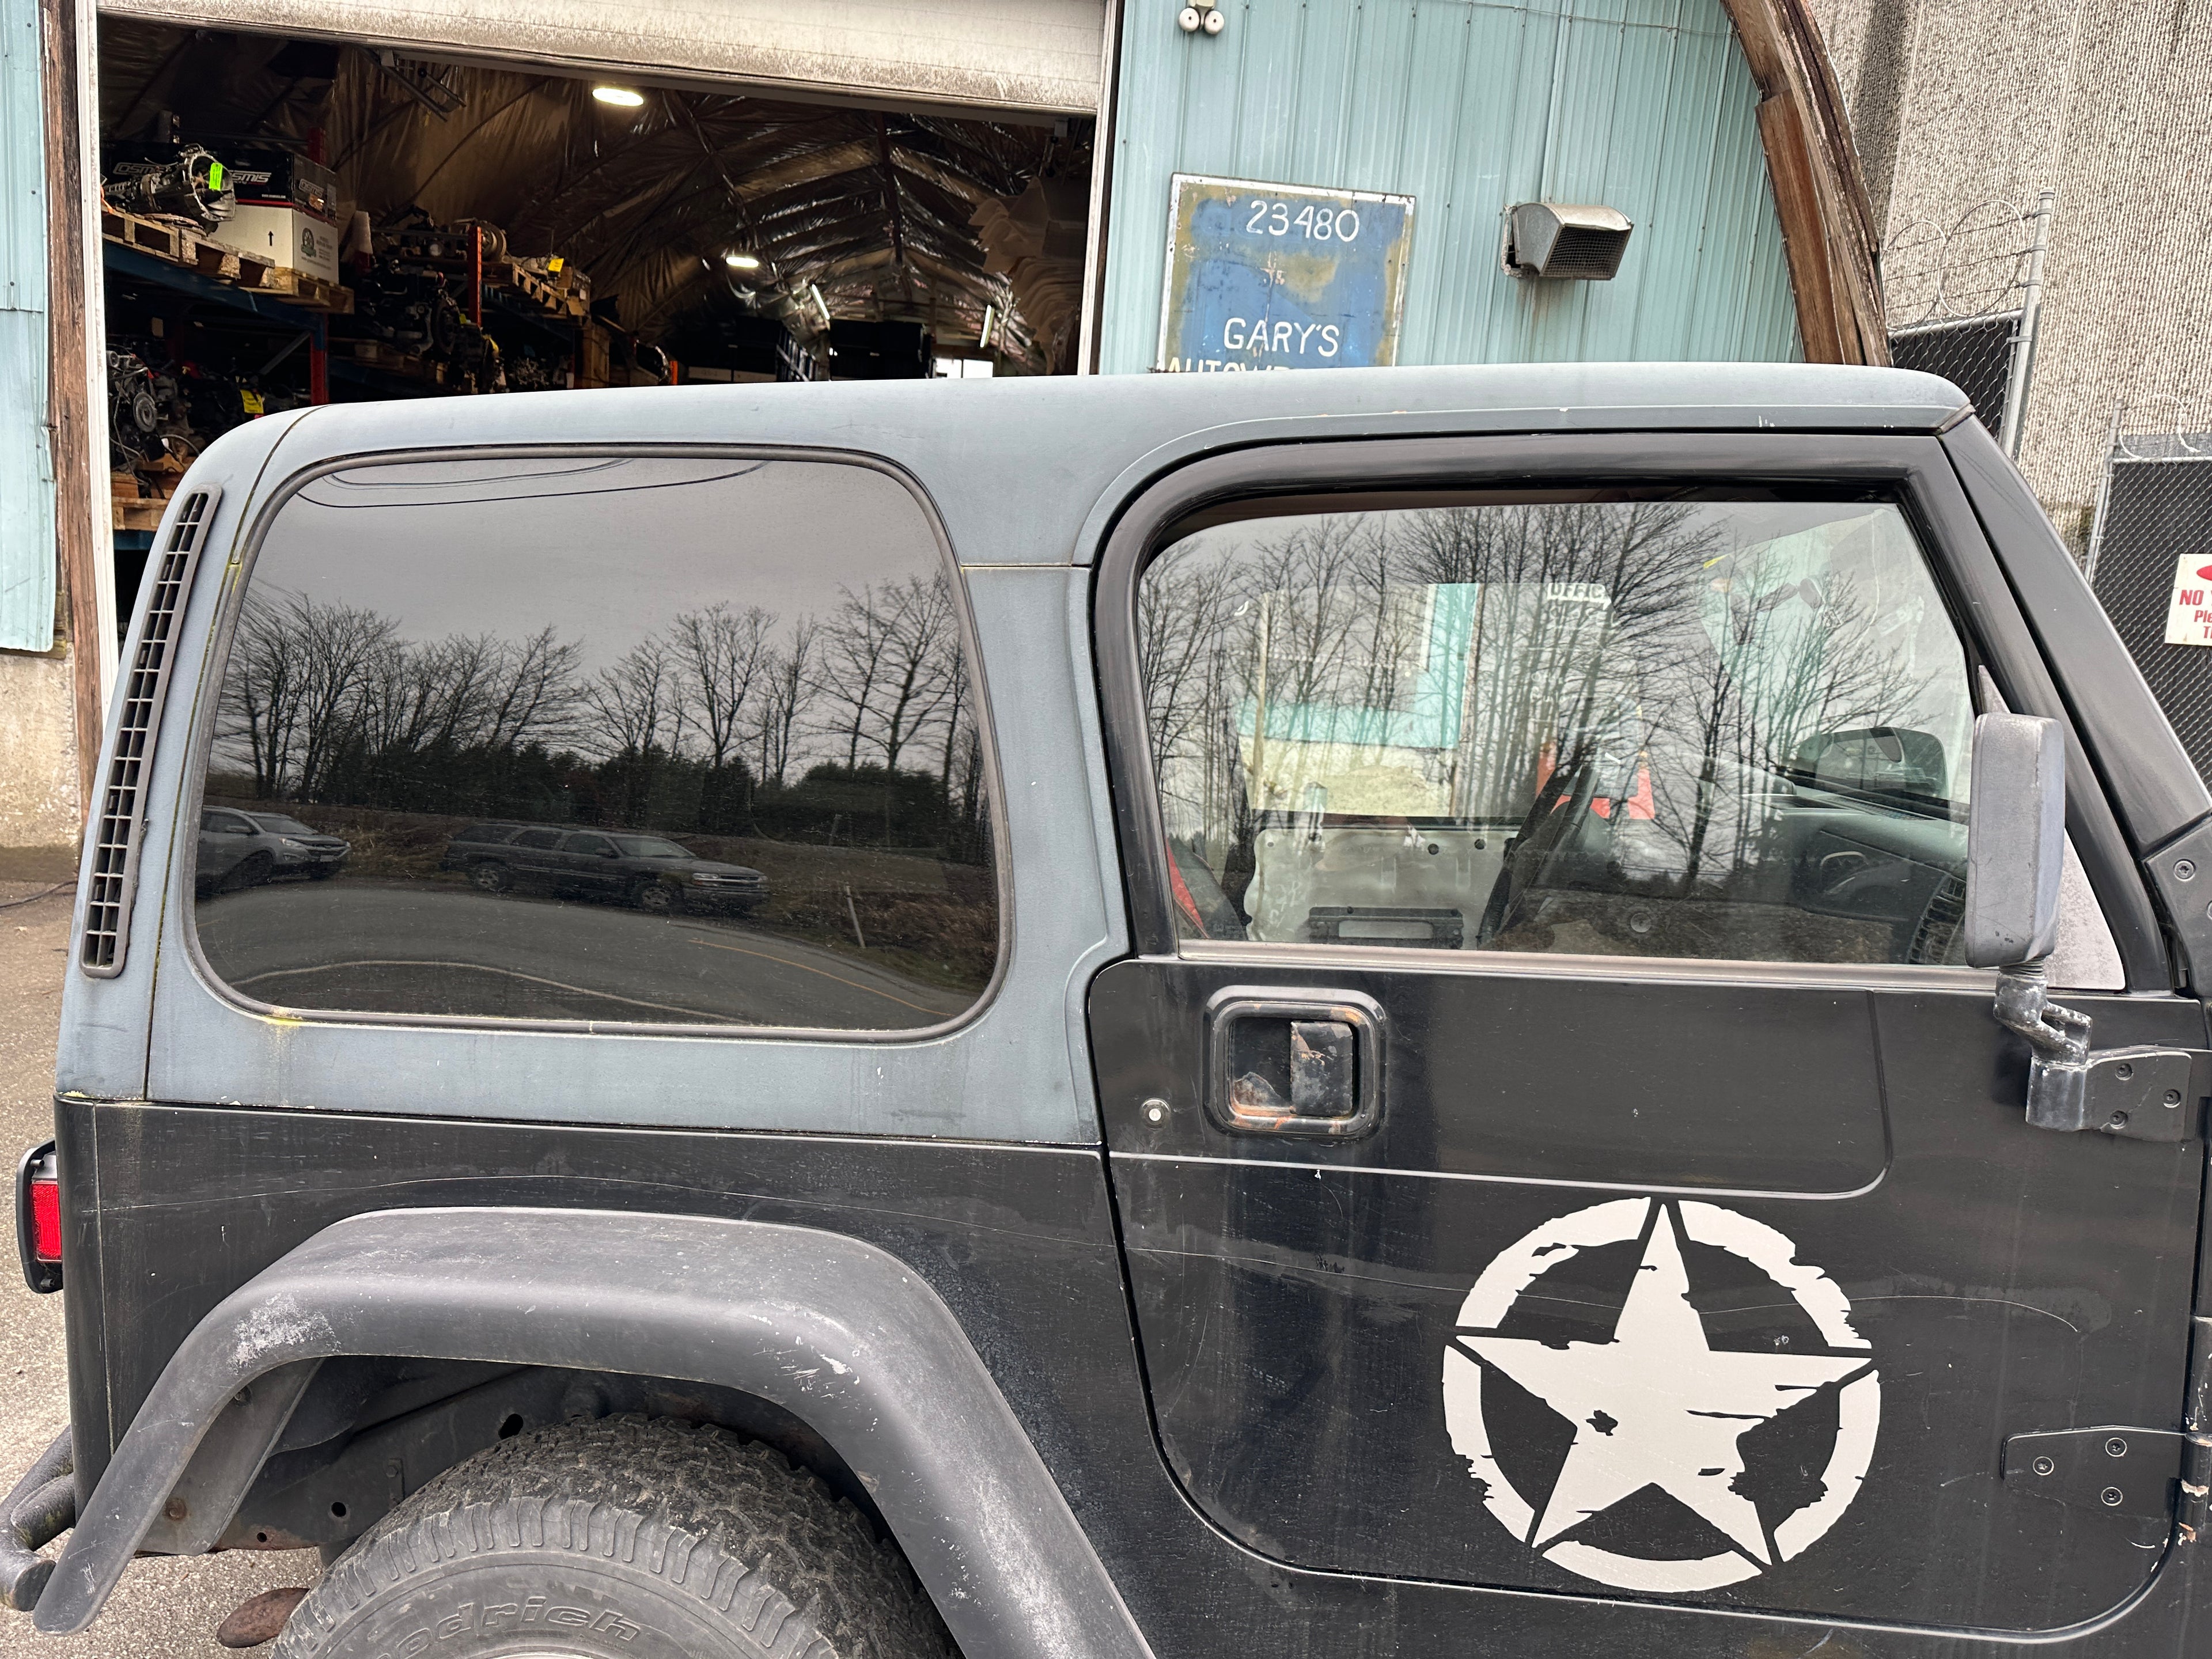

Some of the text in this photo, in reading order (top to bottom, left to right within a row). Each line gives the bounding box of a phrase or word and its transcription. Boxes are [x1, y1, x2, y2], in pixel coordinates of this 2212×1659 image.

[1246, 199, 1360, 243] 23480
[1224, 317, 1340, 357] GARY'S
[2179, 589, 2205, 606] NO
[2203, 626, 2212, 639] T
